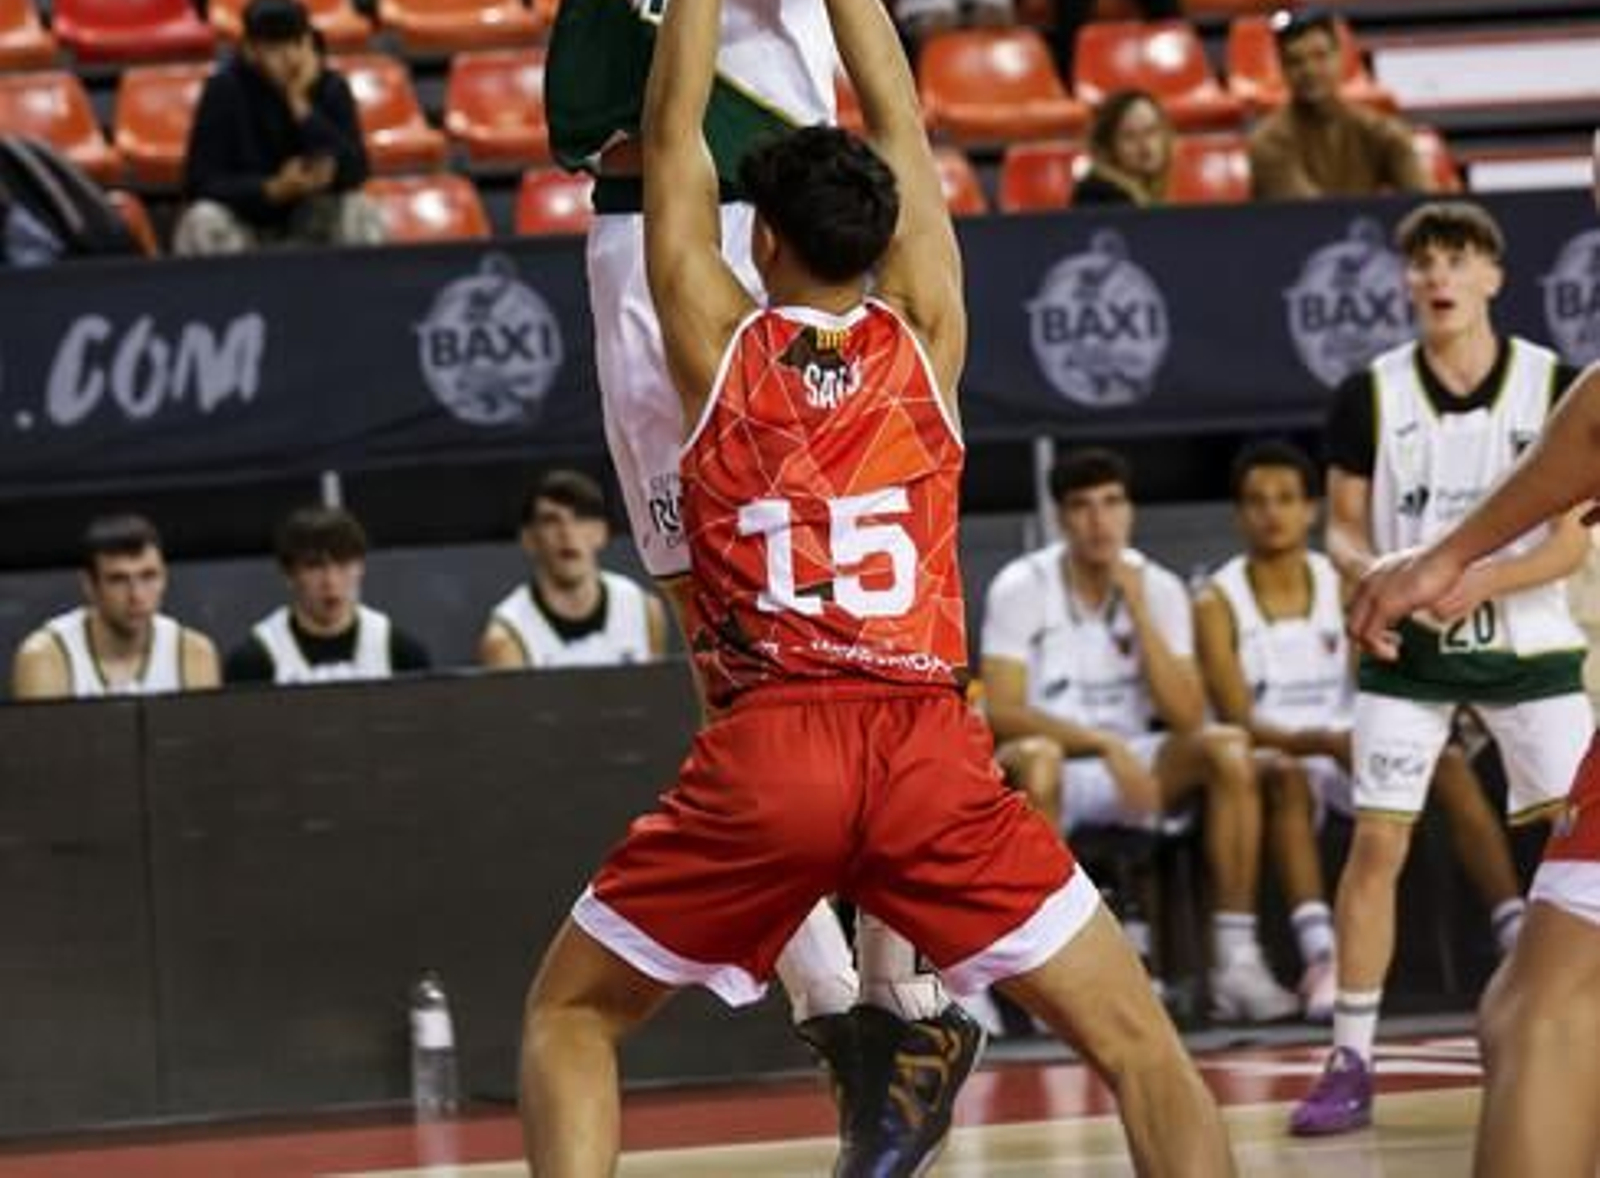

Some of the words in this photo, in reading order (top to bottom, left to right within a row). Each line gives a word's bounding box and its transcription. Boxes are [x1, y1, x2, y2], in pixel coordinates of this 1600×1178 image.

[429, 322, 552, 368] BAXI
[1042, 300, 1159, 344] BAXI
[737, 486, 918, 619] 15
[1443, 600, 1496, 649] 20
